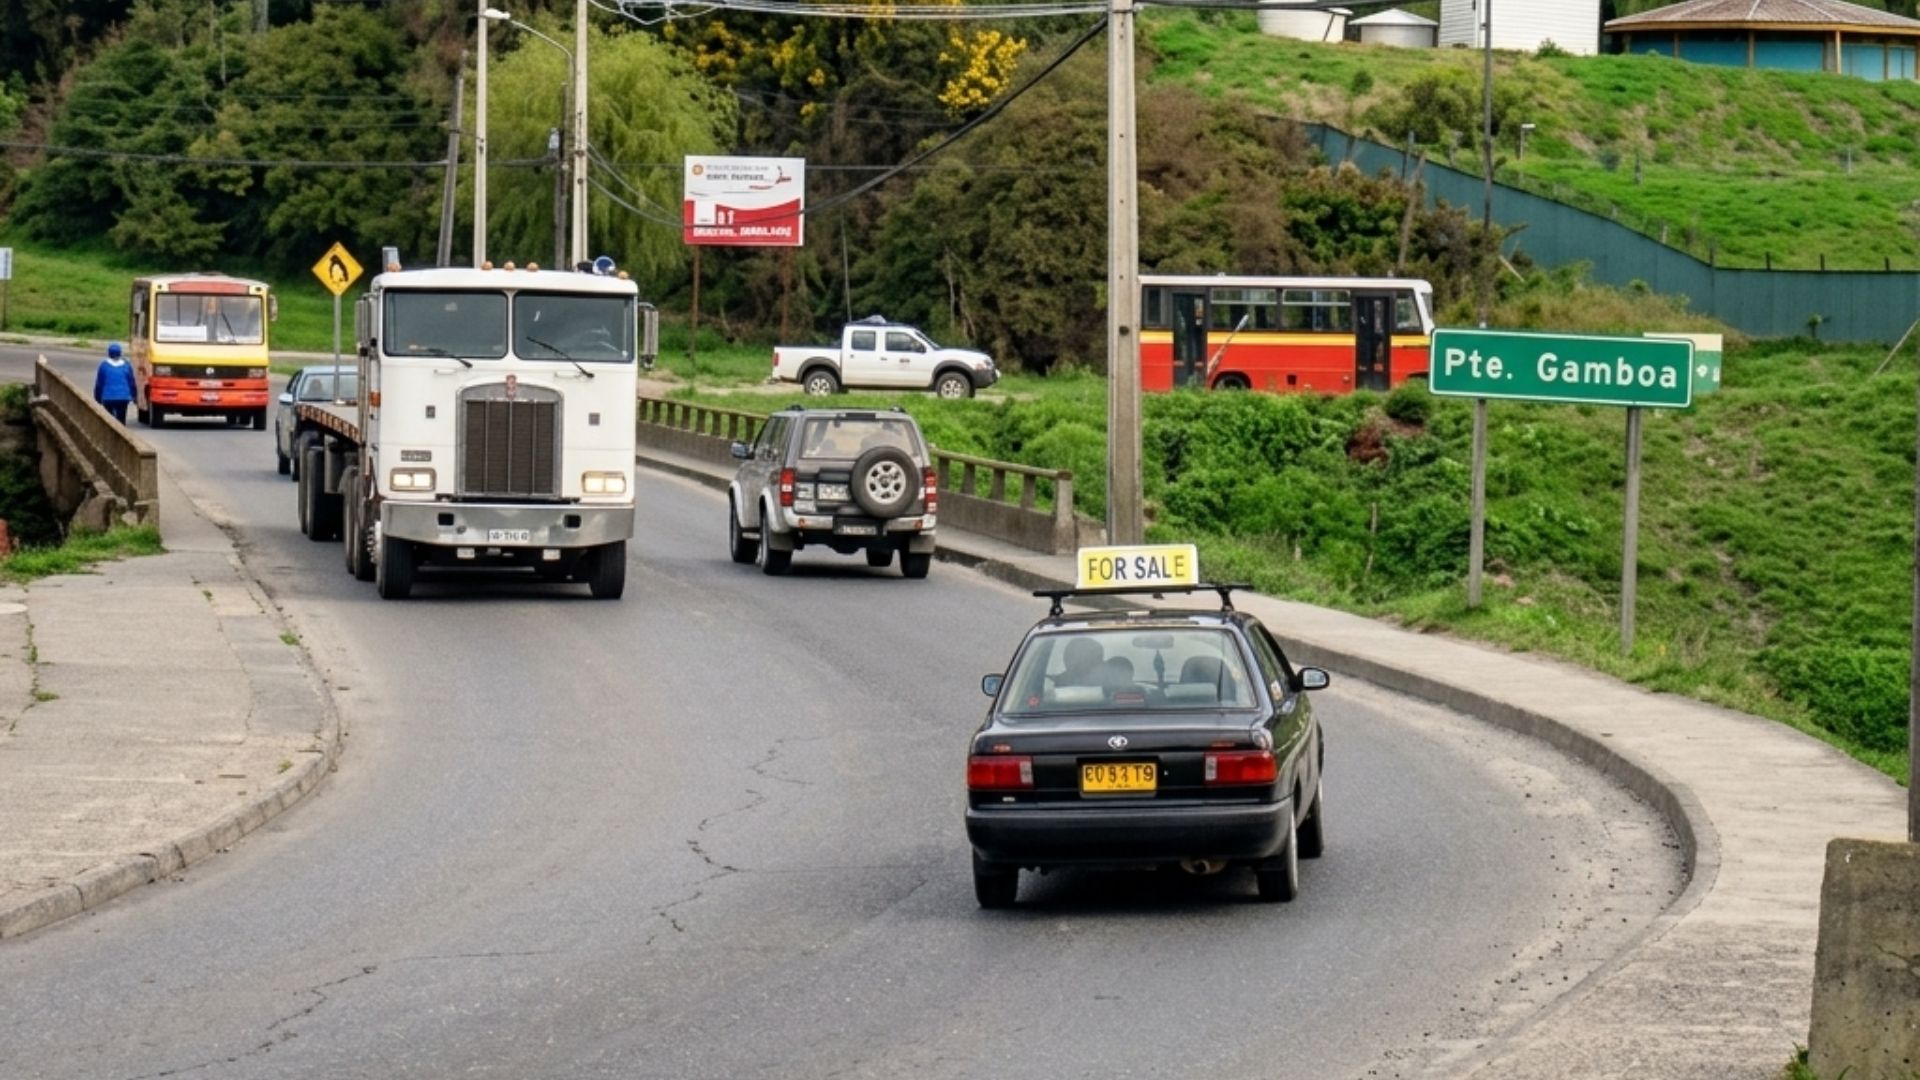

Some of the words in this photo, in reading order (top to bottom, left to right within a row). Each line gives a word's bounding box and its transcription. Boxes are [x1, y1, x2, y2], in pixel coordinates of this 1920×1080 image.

[1444, 348, 1514, 379] Pte.
[1536, 352, 1677, 388] Gamboa
[1087, 556, 1127, 580] FOR
[1134, 555, 1185, 579] SALE
